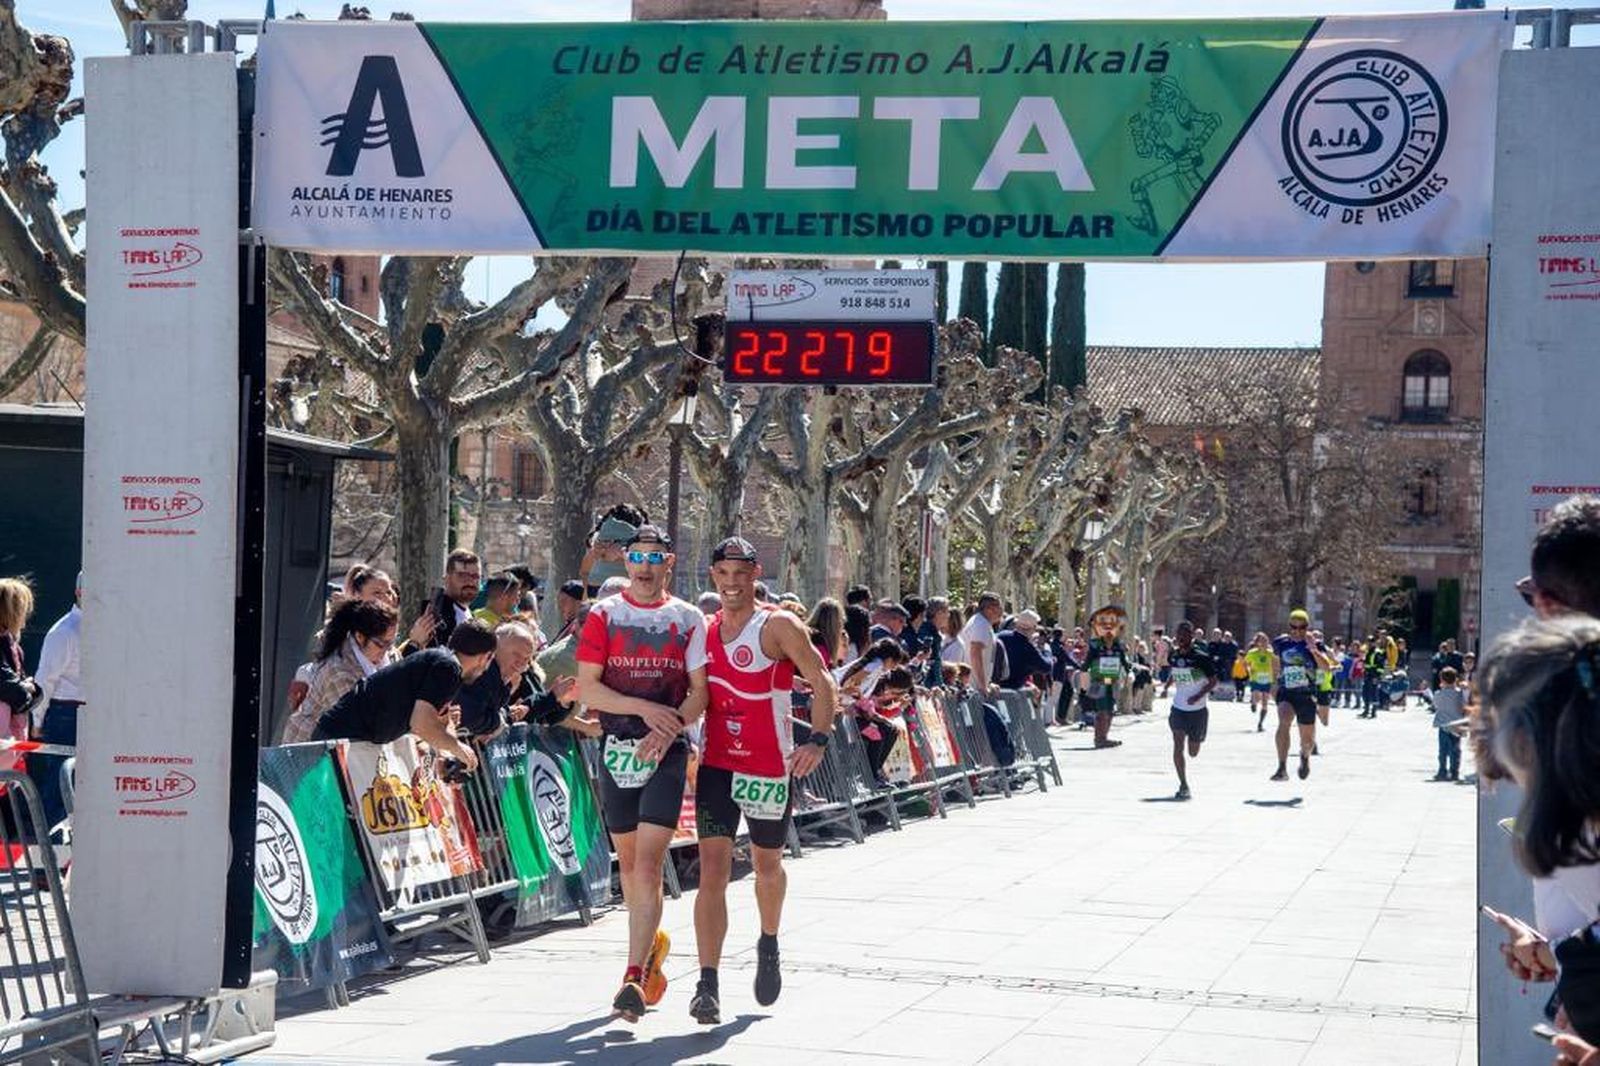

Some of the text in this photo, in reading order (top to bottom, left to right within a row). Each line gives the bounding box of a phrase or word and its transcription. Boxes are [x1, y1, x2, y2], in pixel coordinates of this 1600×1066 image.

[552, 40, 1171, 76] Club de Atletismo A.J.Alkalá
[1355, 59, 1411, 87] CLUB
[609, 95, 1096, 191] META
[291, 183, 453, 204] ALCALÁ DE HENARES
[1277, 171, 1449, 226] ALCALA DE HENARES
[290, 204, 452, 221] AYUNTAMIENTO
[585, 200, 1116, 239] DÍA DEL ATLETISMO POPULAR
[123, 250, 187, 264] TIMING LAP
[1539, 257, 1586, 274] TIMING
[734, 282, 797, 298] TIMING LAP
[824, 276, 931, 288] SERVICIOS DEPORTIVOS
[840, 297, 911, 309] 918 848 514
[123, 496, 188, 511] TIMING LAP
[114, 776, 180, 792] TIMING LAP
[734, 778, 786, 803] 2678
